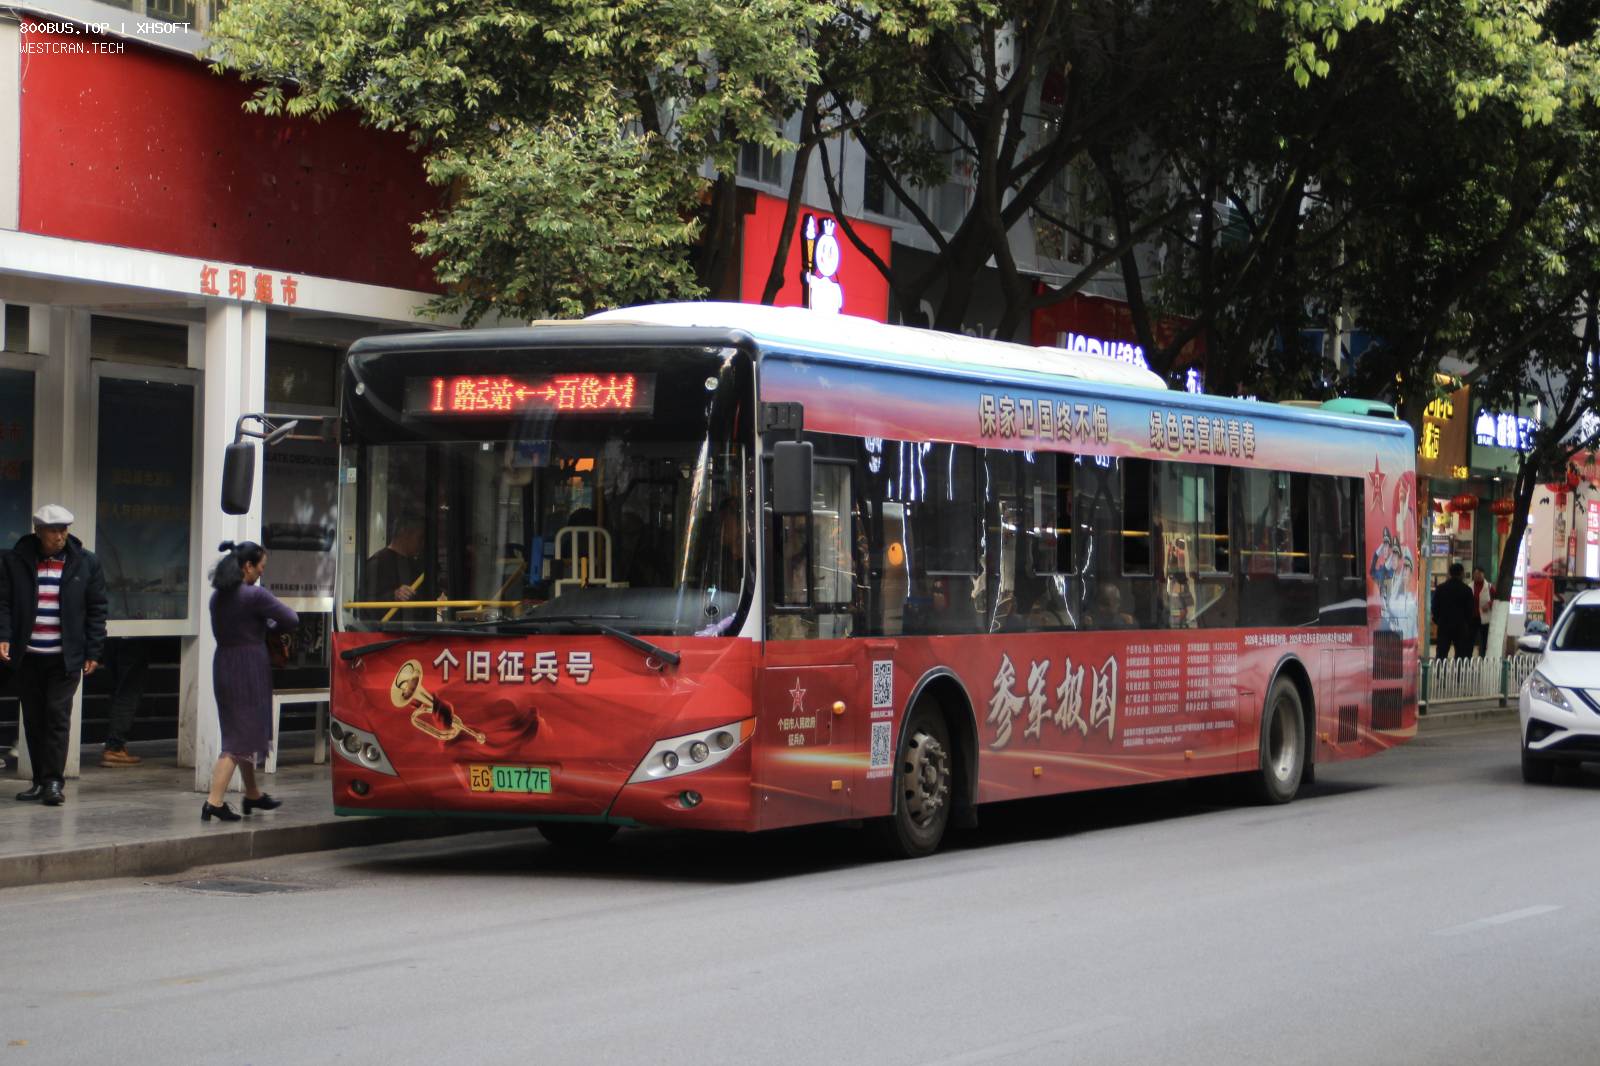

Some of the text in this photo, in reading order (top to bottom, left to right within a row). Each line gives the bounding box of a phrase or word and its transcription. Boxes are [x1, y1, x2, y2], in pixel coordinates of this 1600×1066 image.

[201, 264, 298, 304] 红印超市
[433, 377, 443, 411] 1
[979, 393, 1256, 458] 保家卫国终不悔 绿色军营献青春
[433, 648, 594, 683] 个旧征兵号
[986, 653, 1118, 749] 参军报国
